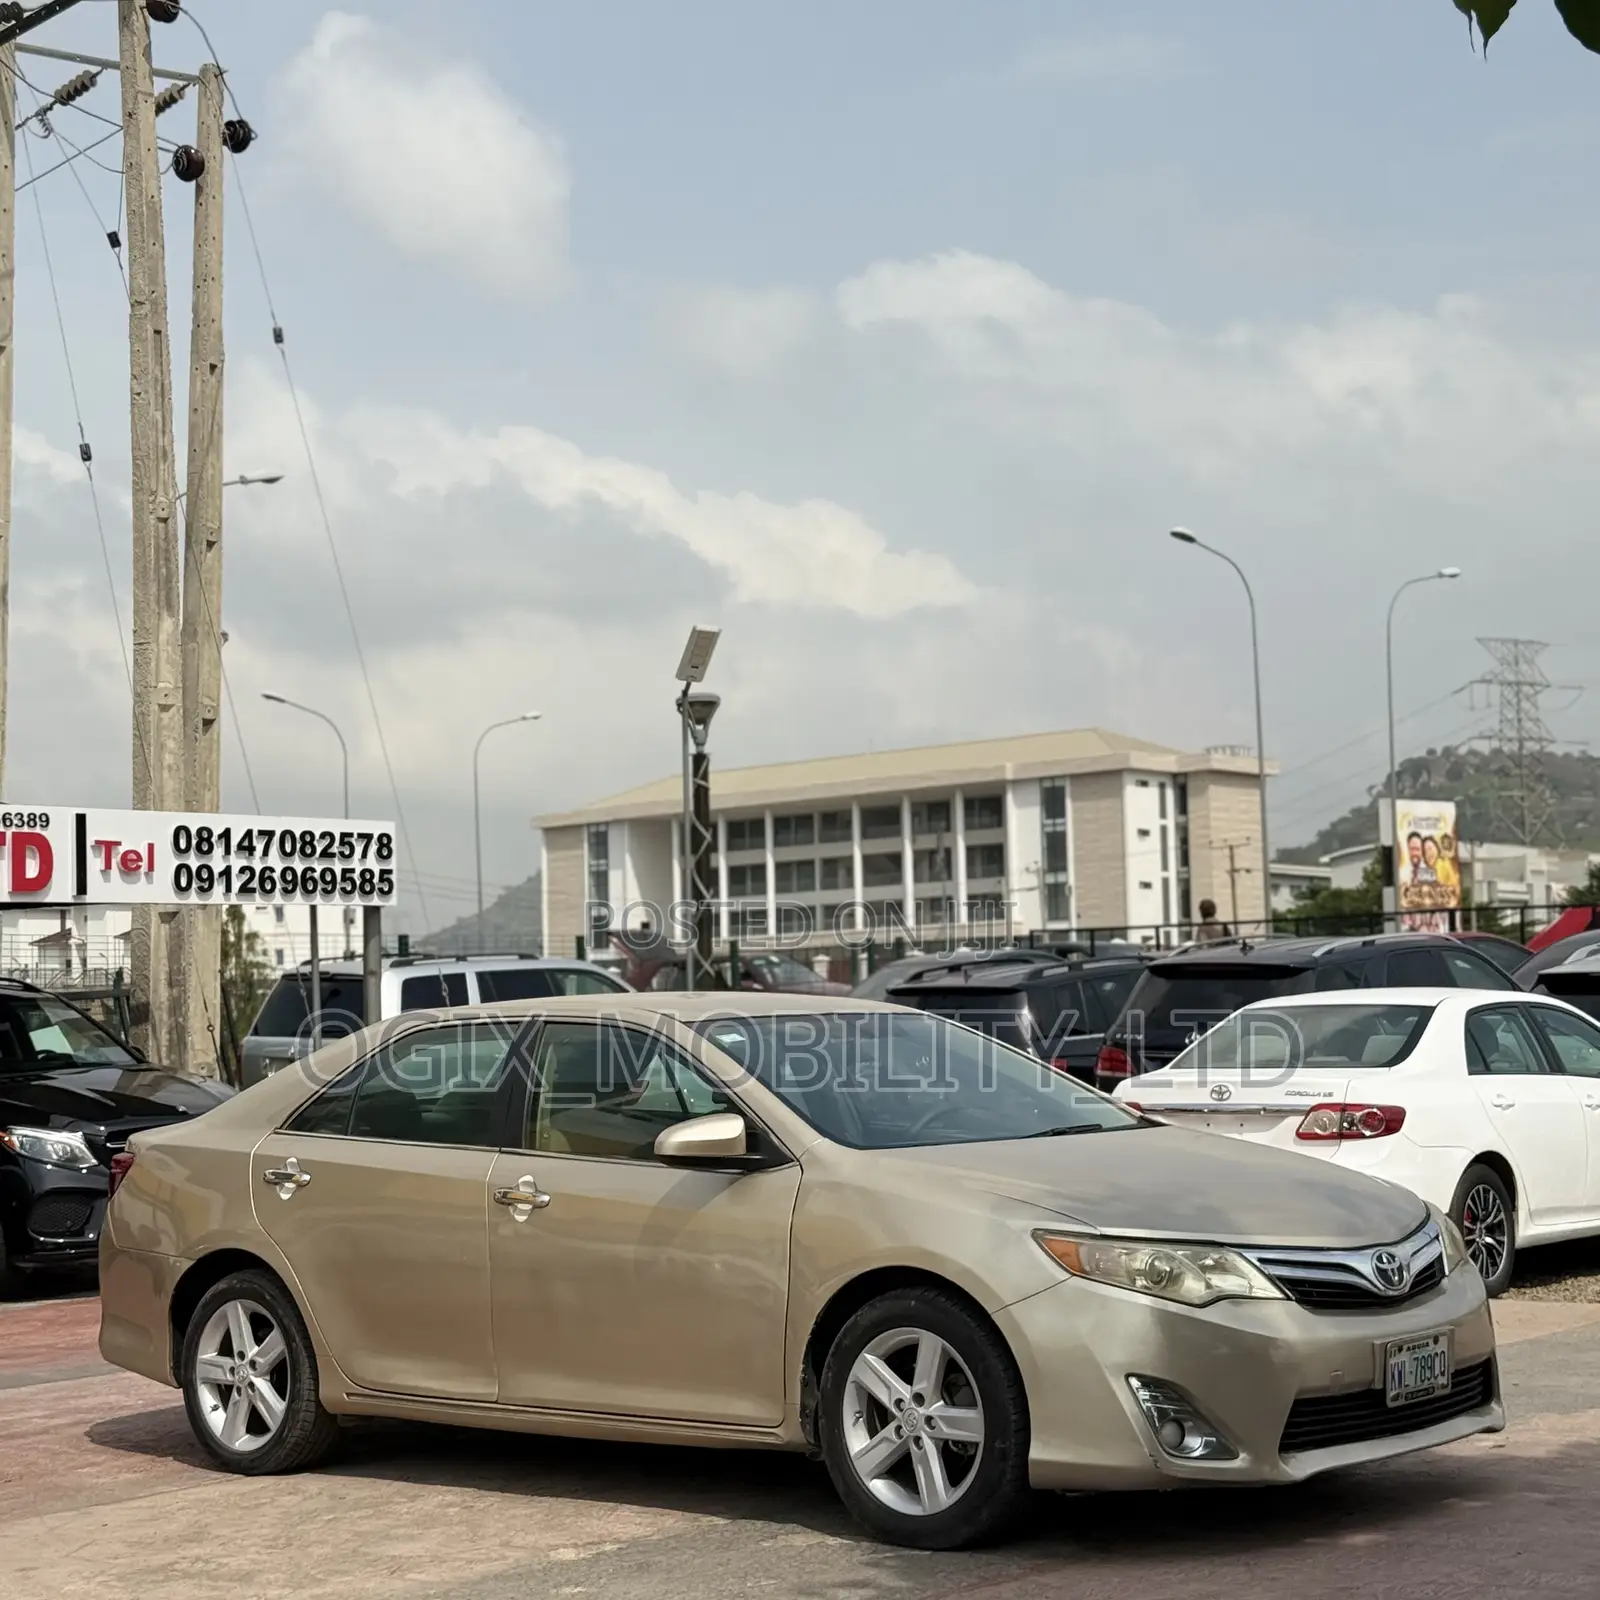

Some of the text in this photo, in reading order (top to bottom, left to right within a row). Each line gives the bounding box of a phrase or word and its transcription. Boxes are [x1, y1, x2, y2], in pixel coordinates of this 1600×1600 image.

[94, 840, 154, 873] Tel
[172, 825, 393, 860] 08147082578
[173, 863, 394, 896] 09126969585
